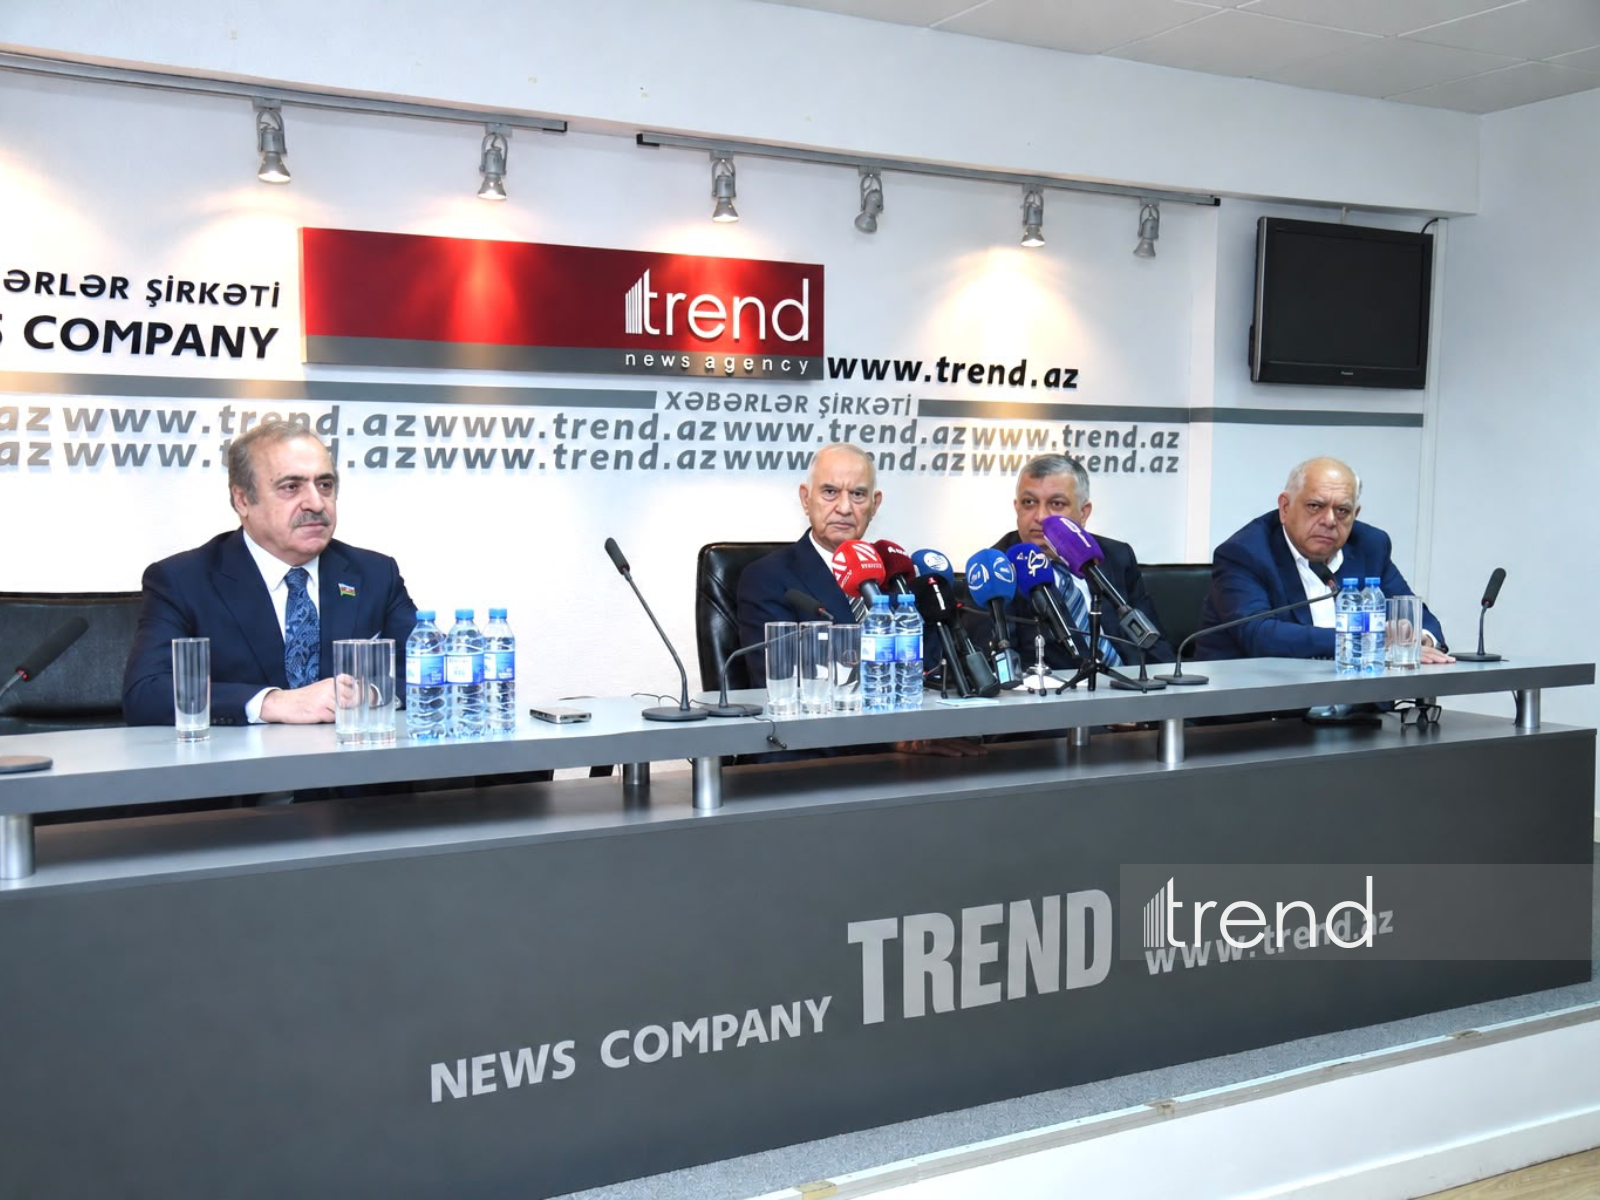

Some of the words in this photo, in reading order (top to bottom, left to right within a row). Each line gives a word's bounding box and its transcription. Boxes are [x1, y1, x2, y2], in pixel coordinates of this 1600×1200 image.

[145, 275, 280, 307] ŞİRKƏTİ
[643, 268, 809, 341] trend
[23, 315, 279, 359] COMPANY
[625, 353, 690, 368] news
[705, 355, 808, 375] agency
[827, 356, 1079, 388] www.trend.az
[664, 391, 808, 413] XƏBƏRLƏR
[818, 392, 911, 419] ŞİRKƏTİ
[423, 412, 717, 441] www.trend.az
[723, 418, 966, 444] www.trend.az
[972, 424, 1180, 449] www.trend.az
[423, 442, 717, 470] www.trend.az
[430, 1040, 576, 1103] NEWS
[600, 996, 832, 1069] COMPANY
[847, 889, 1113, 1025] TREND
